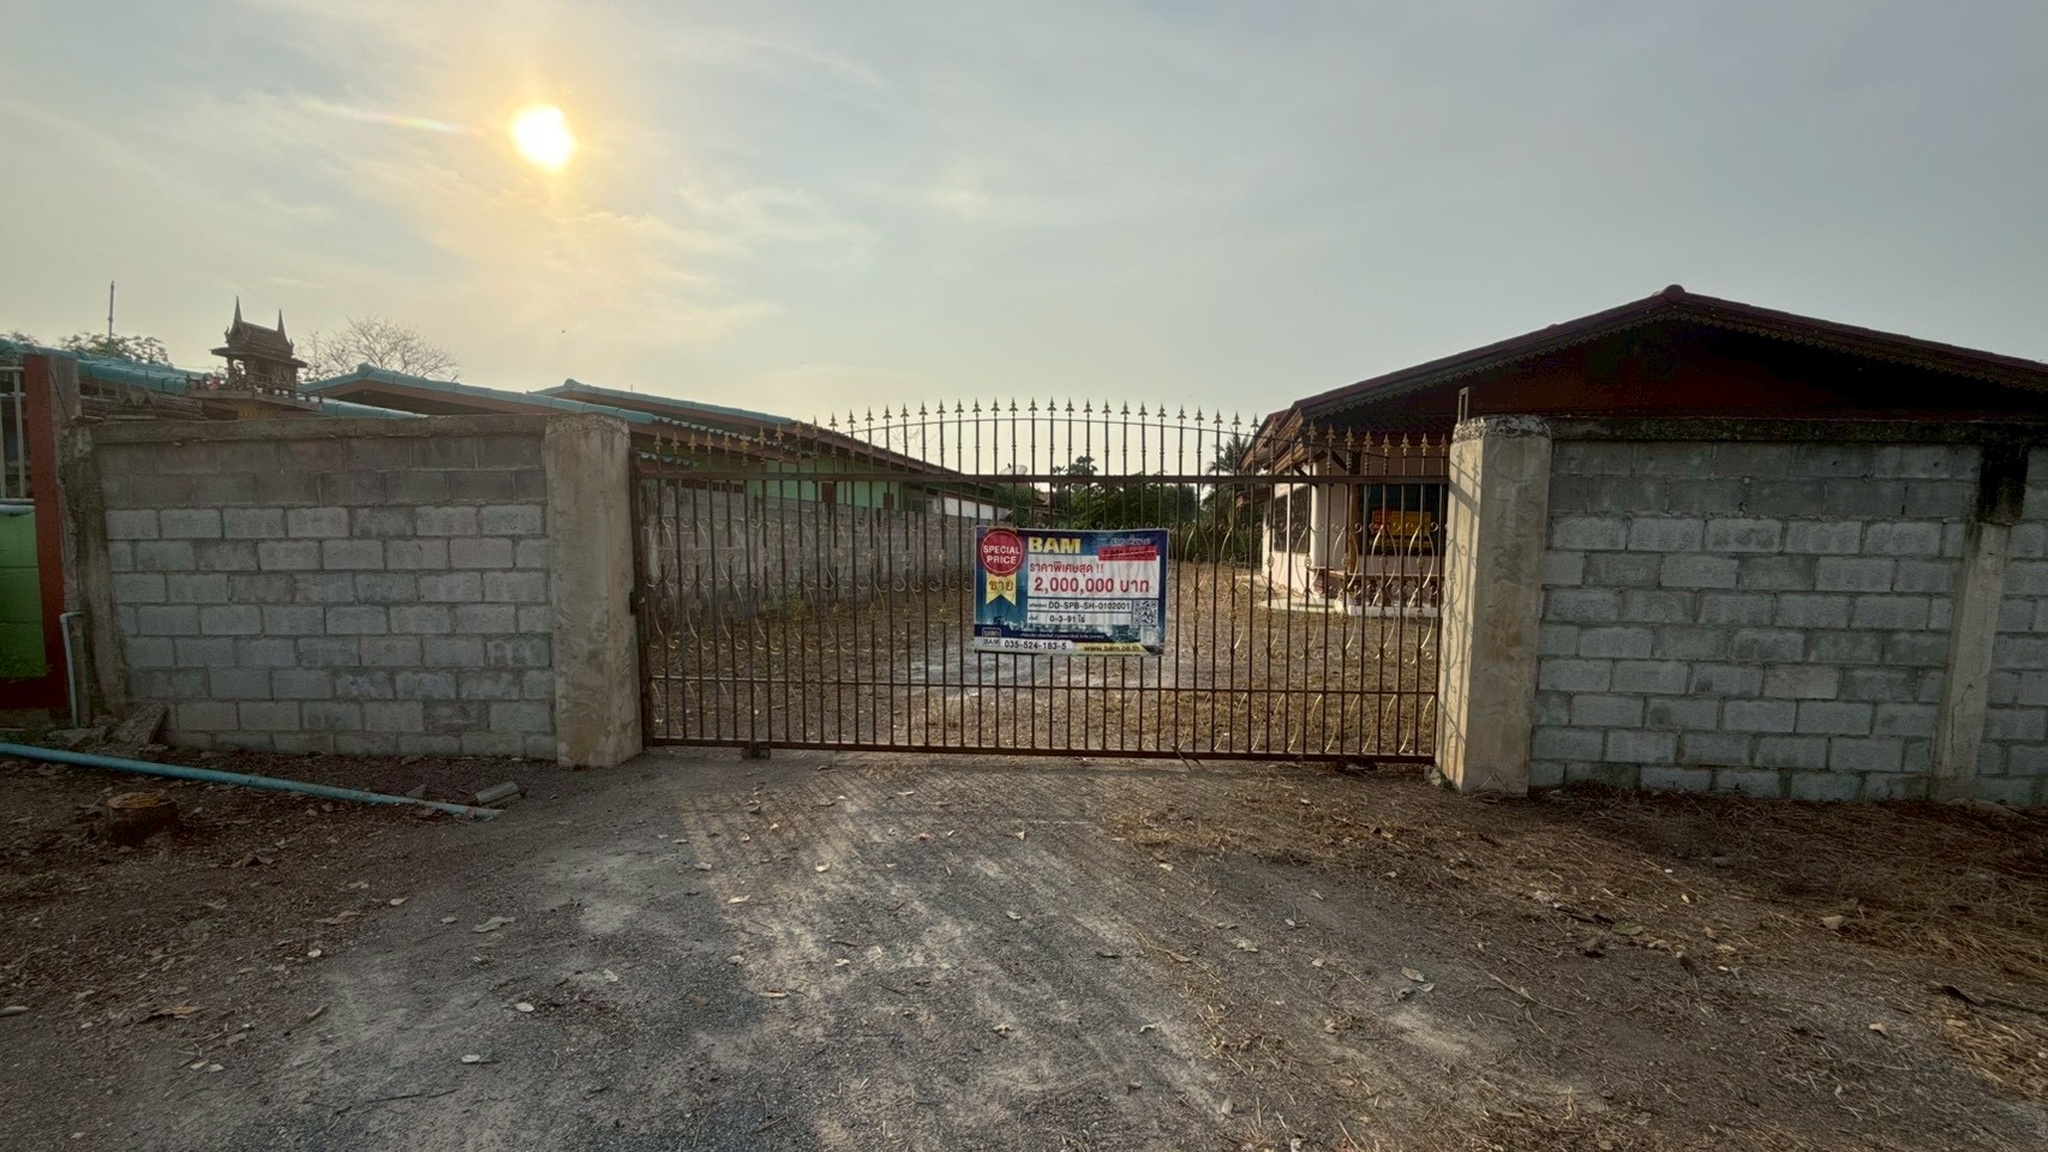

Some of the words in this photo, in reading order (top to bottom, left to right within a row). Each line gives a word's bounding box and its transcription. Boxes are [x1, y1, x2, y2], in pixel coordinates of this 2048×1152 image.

[983, 545, 1020, 555] SPECIAL
[1028, 536, 1081, 554] BAM
[986, 555, 1017, 565] PRICE
[1029, 561, 1093, 577] ราคาพิเศษสุด
[989, 580, 1014, 591] ขาย
[1034, 577, 1114, 595] 2,000,000
[1120, 579, 1150, 593] บาท
[1004, 639, 1067, 650] 035-524-183-5
[1084, 645, 1140, 653] www.bam.co.th
